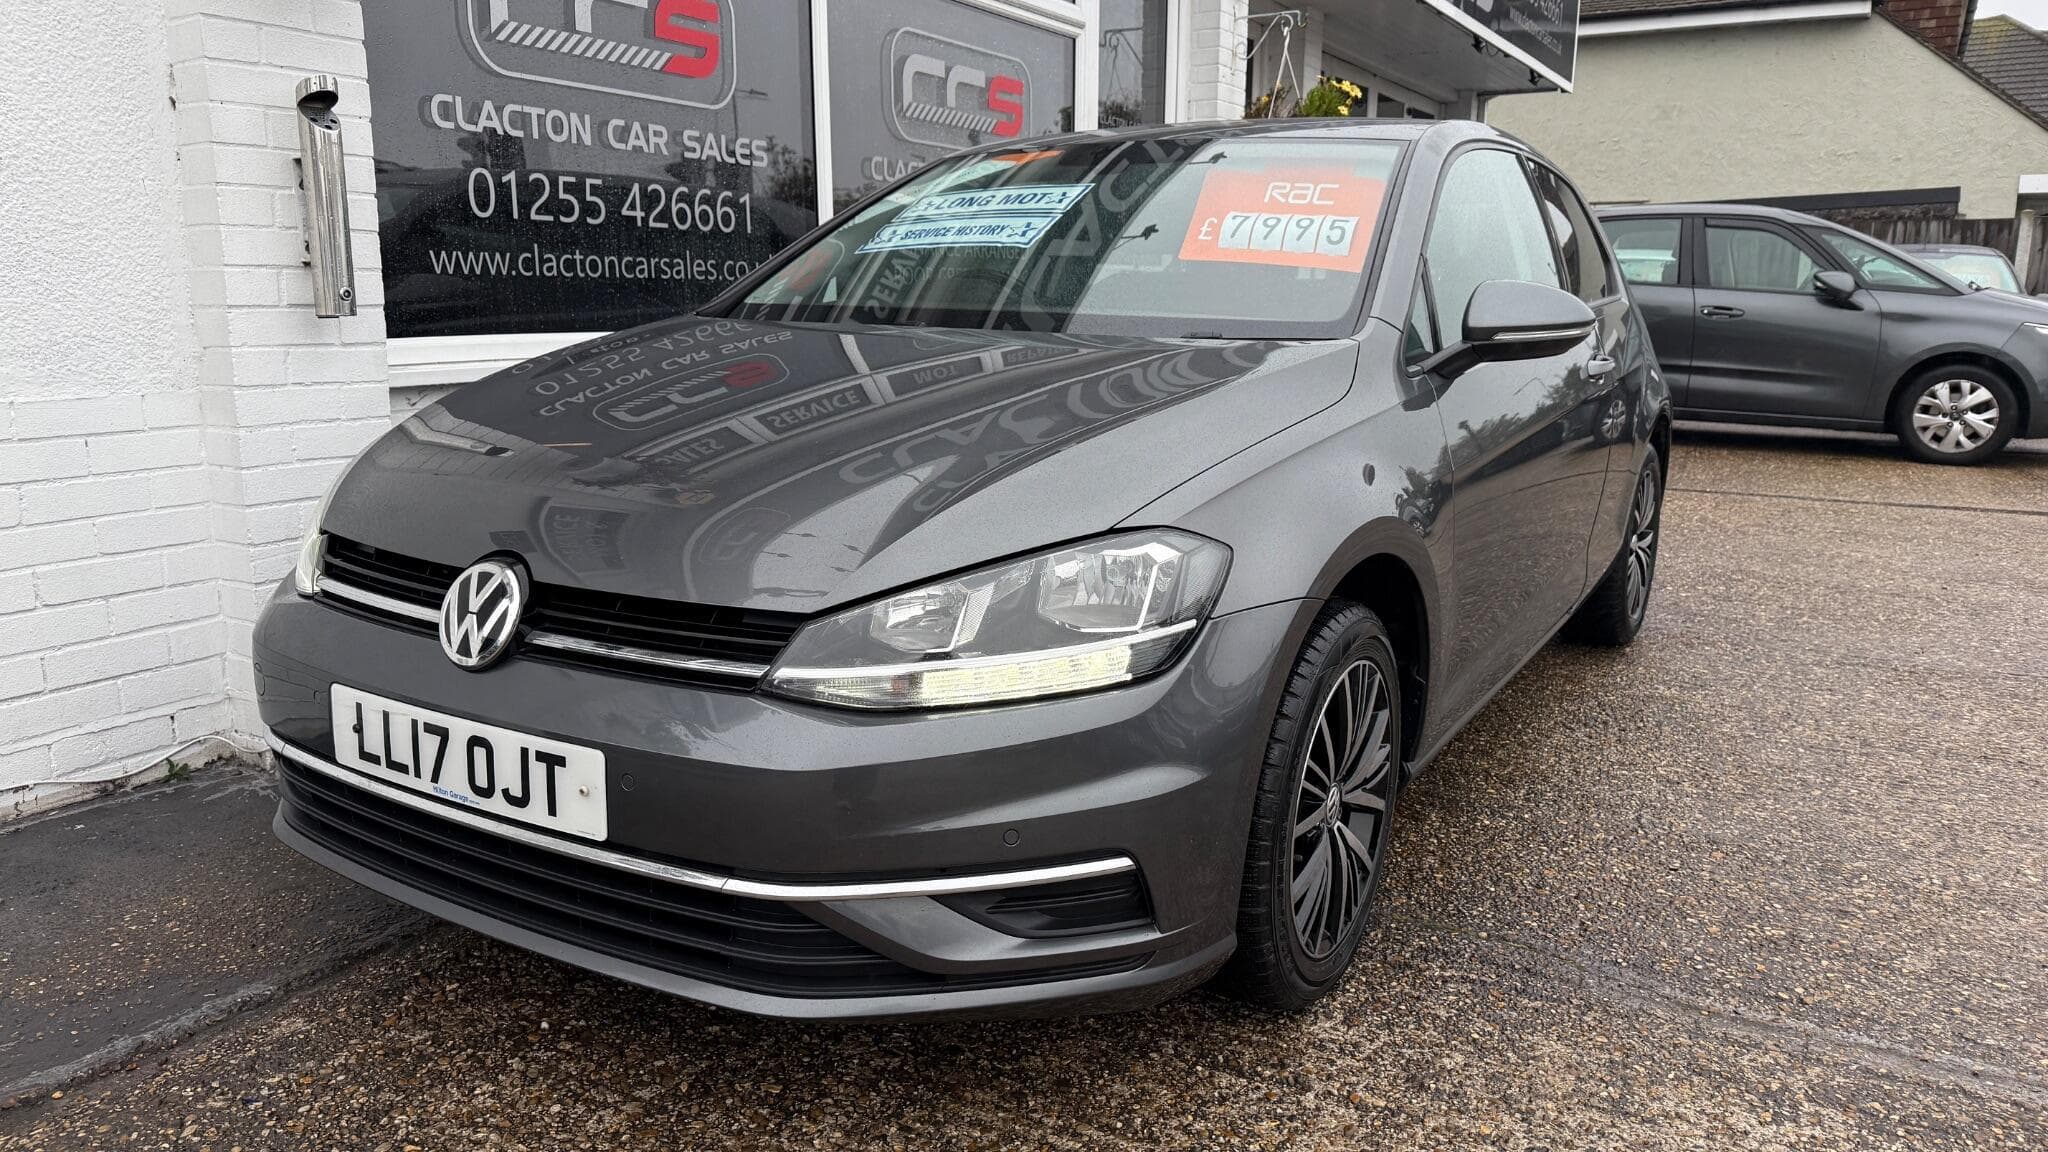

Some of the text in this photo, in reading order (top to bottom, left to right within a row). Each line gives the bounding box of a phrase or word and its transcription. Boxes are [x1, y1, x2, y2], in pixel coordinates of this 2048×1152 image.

[430, 93, 768, 168] CLACTON CAR SALES
[468, 167, 752, 234] 01255 426661
[932, 192, 1053, 210] LONG MOT
[901, 224, 1010, 241] SERVICE HISTORY
[429, 244, 774, 282] www.clactoncarsales.co
[354, 701, 567, 818] LL17 OJT
